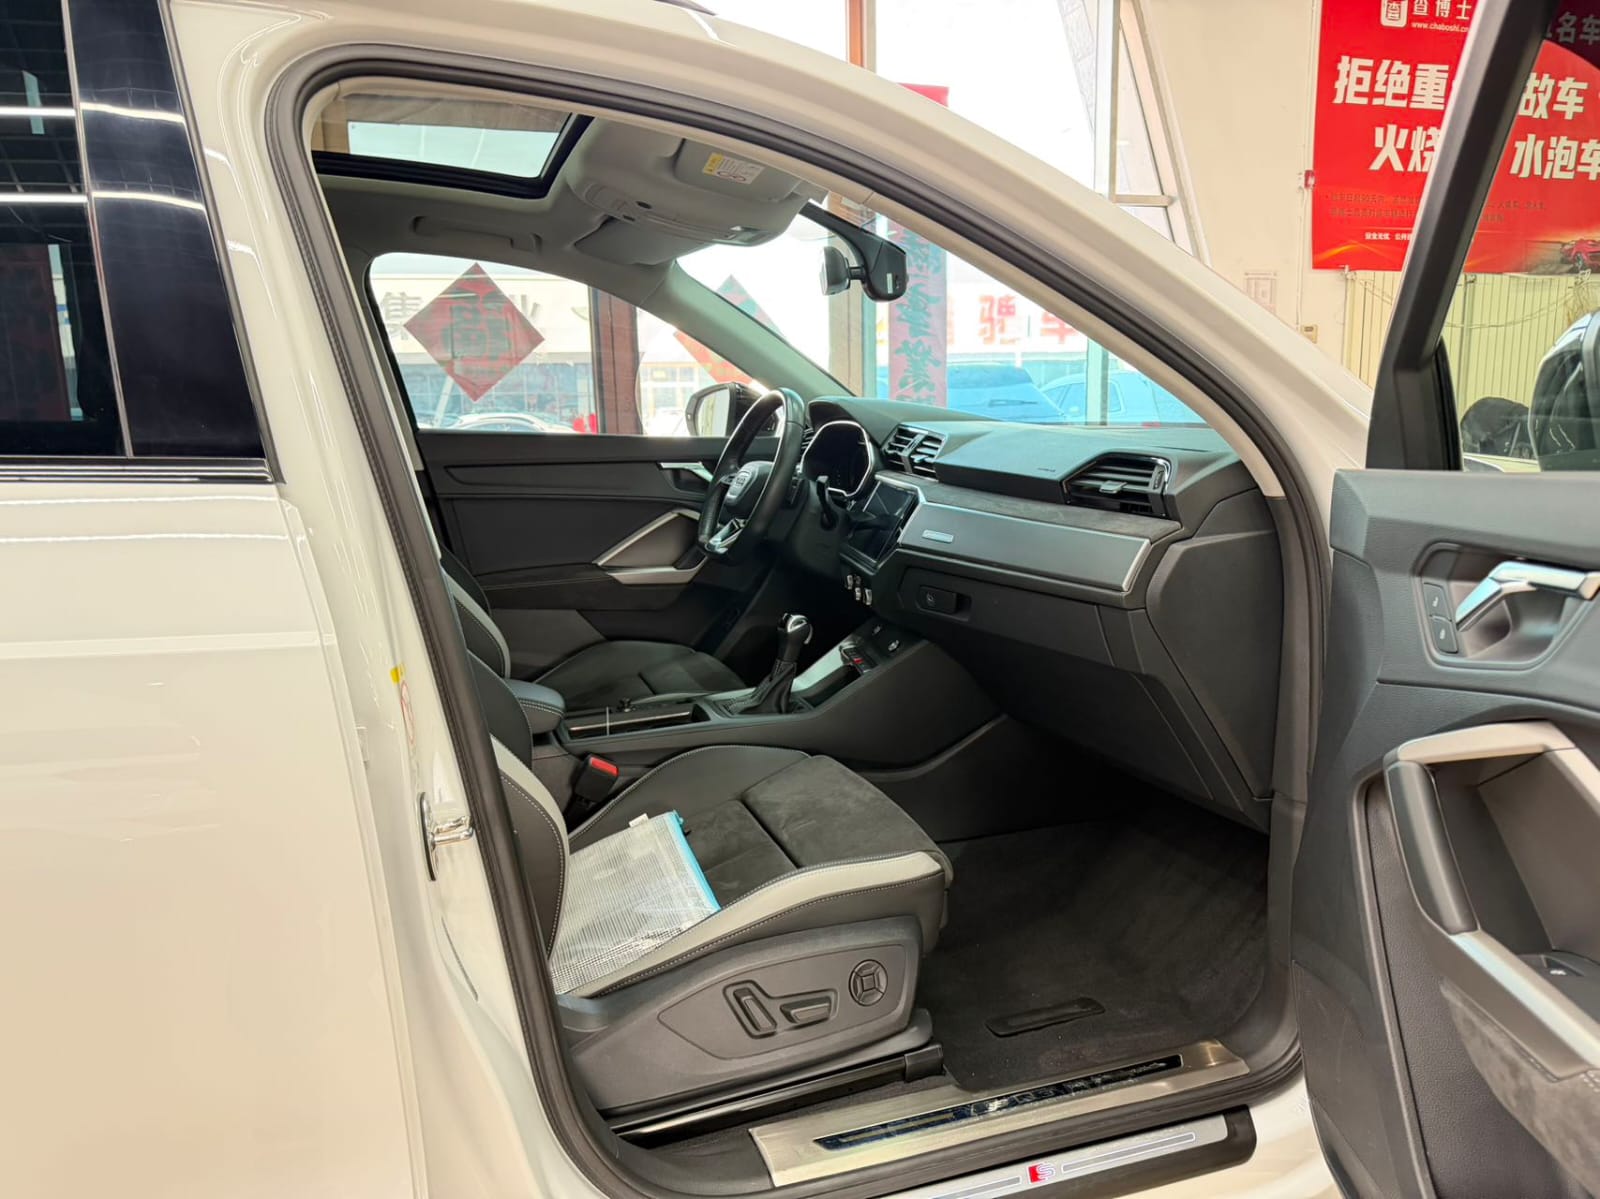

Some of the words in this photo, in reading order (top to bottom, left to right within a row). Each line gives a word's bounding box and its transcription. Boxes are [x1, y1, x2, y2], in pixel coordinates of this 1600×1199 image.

[1412, 0, 1472, 20] 查博士
[1509, 133, 1600, 181] 水泡车
